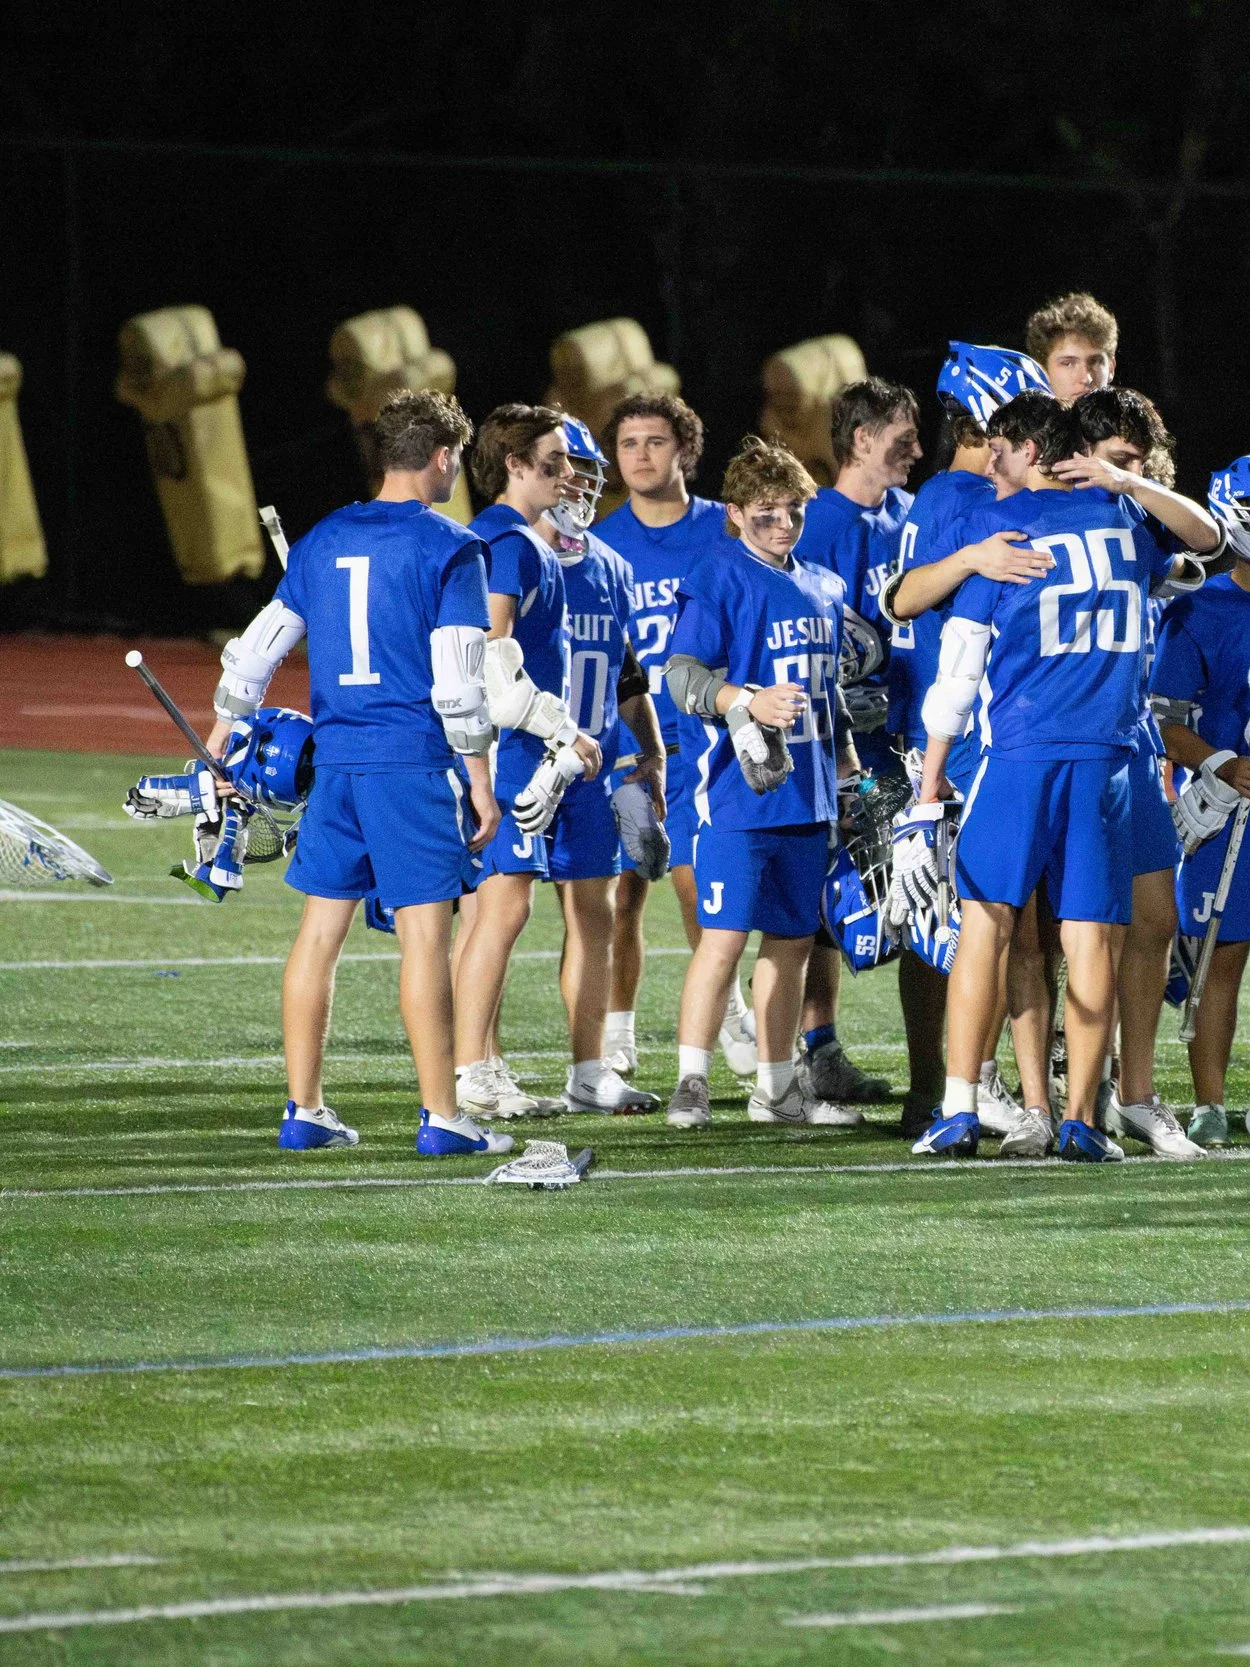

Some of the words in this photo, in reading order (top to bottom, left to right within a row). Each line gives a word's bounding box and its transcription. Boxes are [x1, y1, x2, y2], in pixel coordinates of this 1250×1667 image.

[1029, 527, 1142, 657] 25
[336, 556, 381, 686] 1
[766, 616, 833, 650] JESUIT
[635, 613, 677, 695] 2
[436, 698, 463, 709] STX
[512, 834, 533, 859] J
[703, 881, 725, 915] J
[1193, 891, 1216, 923] J
[855, 934, 877, 957] 55
